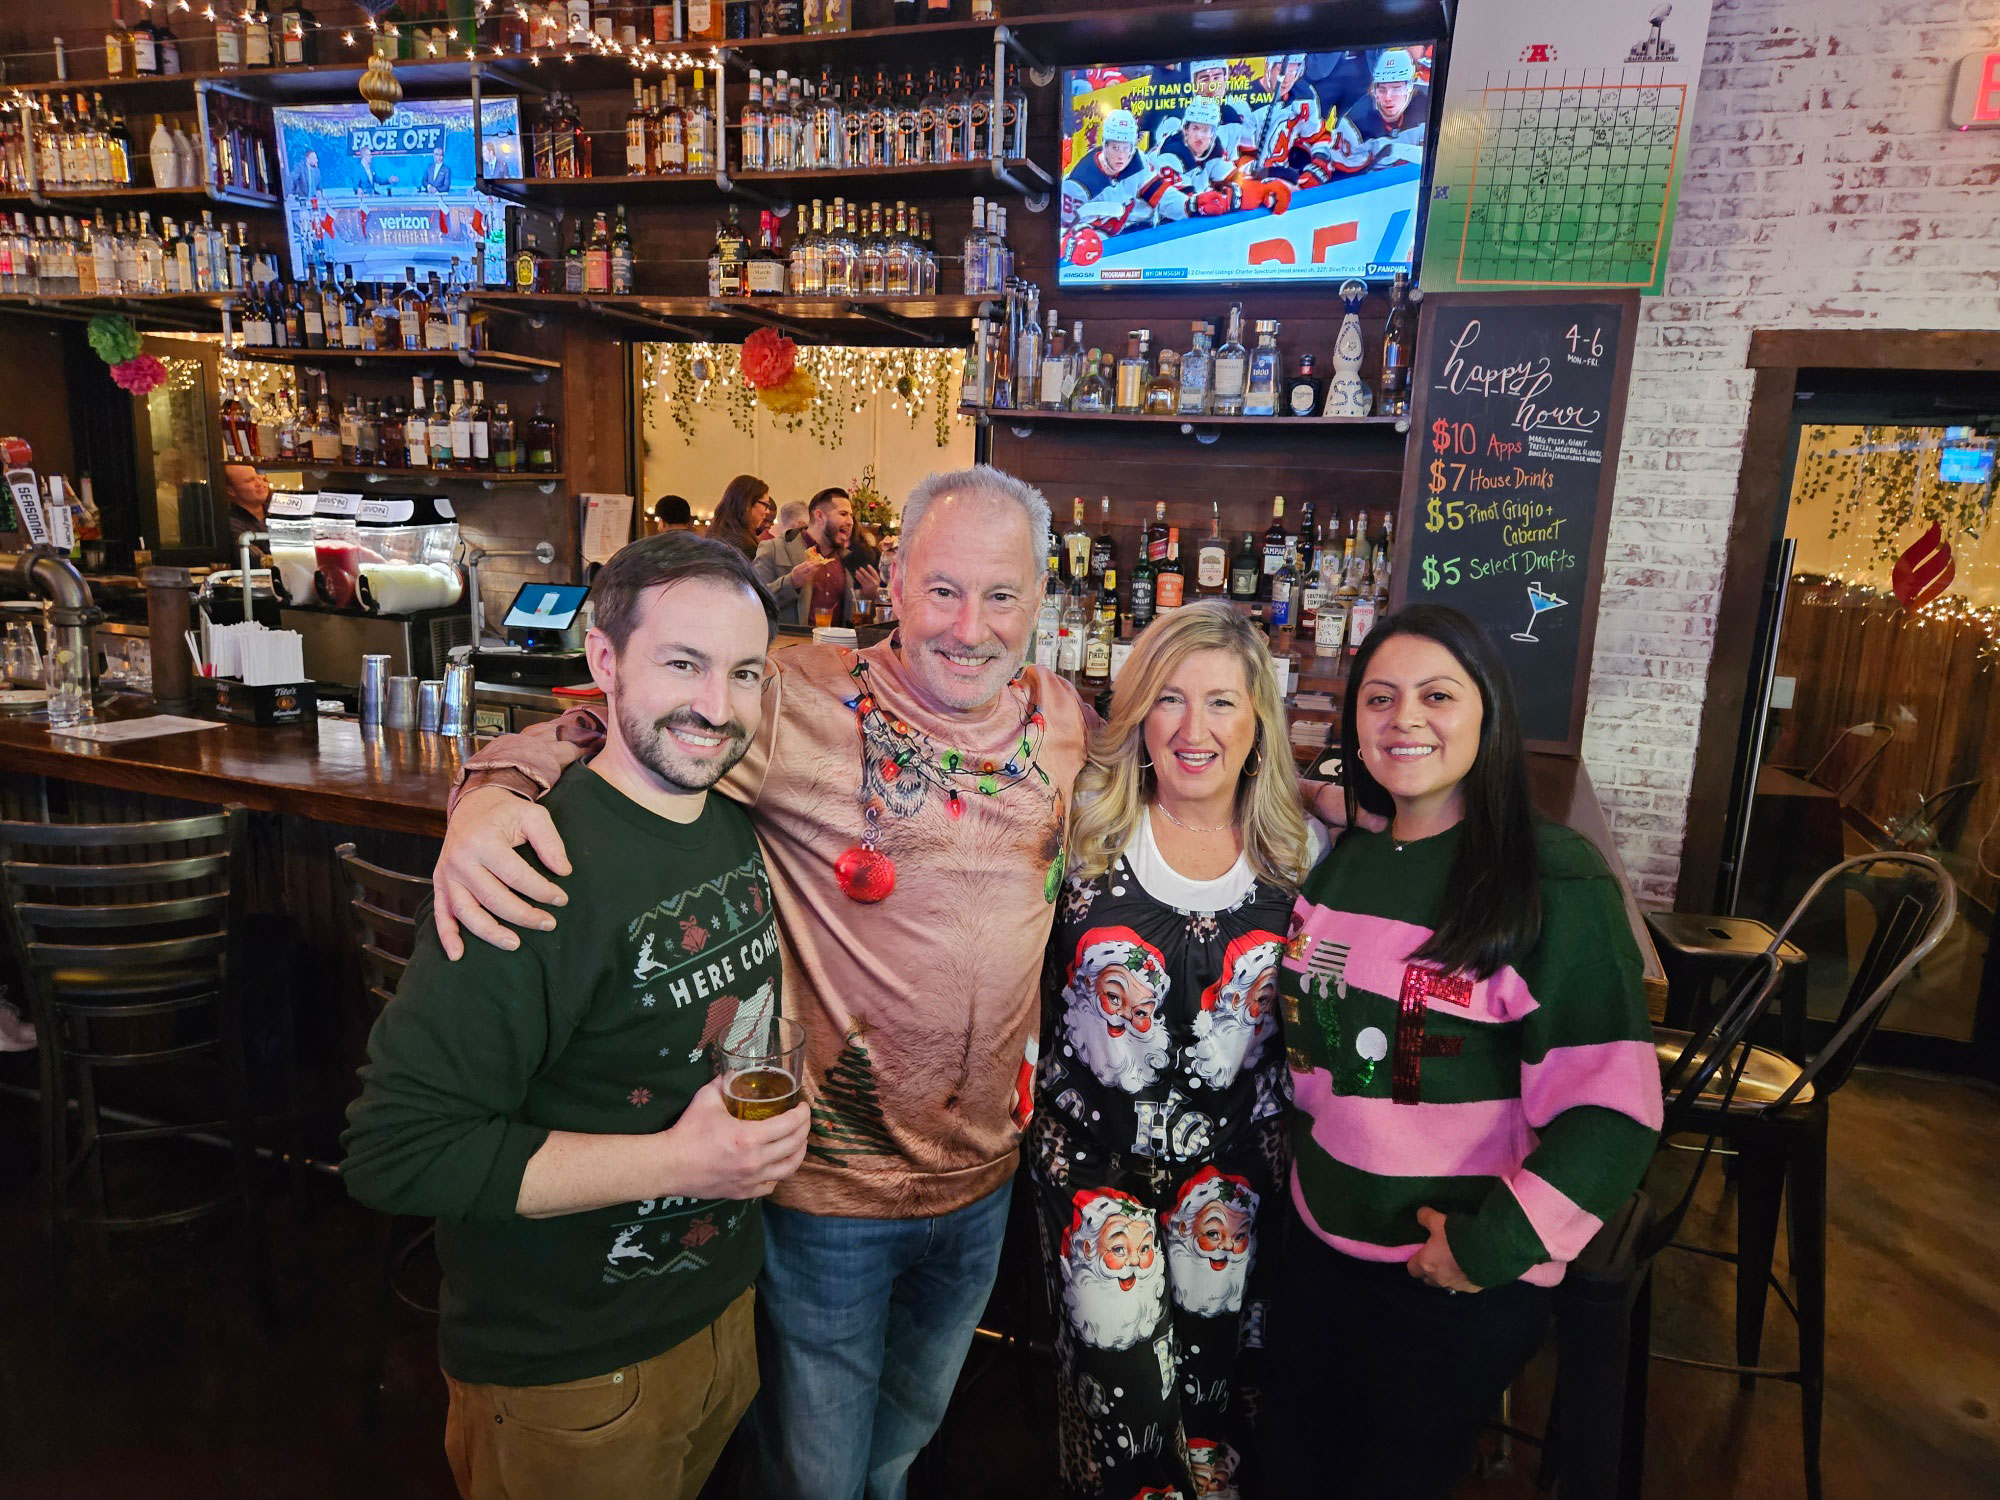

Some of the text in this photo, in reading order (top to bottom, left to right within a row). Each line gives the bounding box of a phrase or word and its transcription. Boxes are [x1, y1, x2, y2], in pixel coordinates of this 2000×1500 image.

[1131, 85, 1157, 97] THEY
[1159, 84, 1181, 96] RAN
[1183, 82, 1205, 95] OUT
[1155, 98, 1176, 111] LIKE
[1249, 92, 1275, 104] SAW
[352, 128, 441, 151] FACE OFF
[379, 213, 430, 230] verizon
[1443, 319, 1551, 398] happy
[1515, 372, 1601, 432] hour
[1432, 416, 1523, 462] $10 Apps
[1428, 458, 1555, 495] $7 House Drinks
[18, 486, 46, 542] SEASONAL
[1424, 496, 1465, 533] $5
[1464, 501, 1500, 525] Pinot
[1502, 498, 1544, 528] Grigio
[1503, 518, 1568, 547] Cabernet
[1263, 547, 1286, 555] CAMPA
[1421, 549, 1576, 591] $5 Select Drafts
[274, 687, 298, 697] Tito's
[668, 955, 736, 1009] HERE
